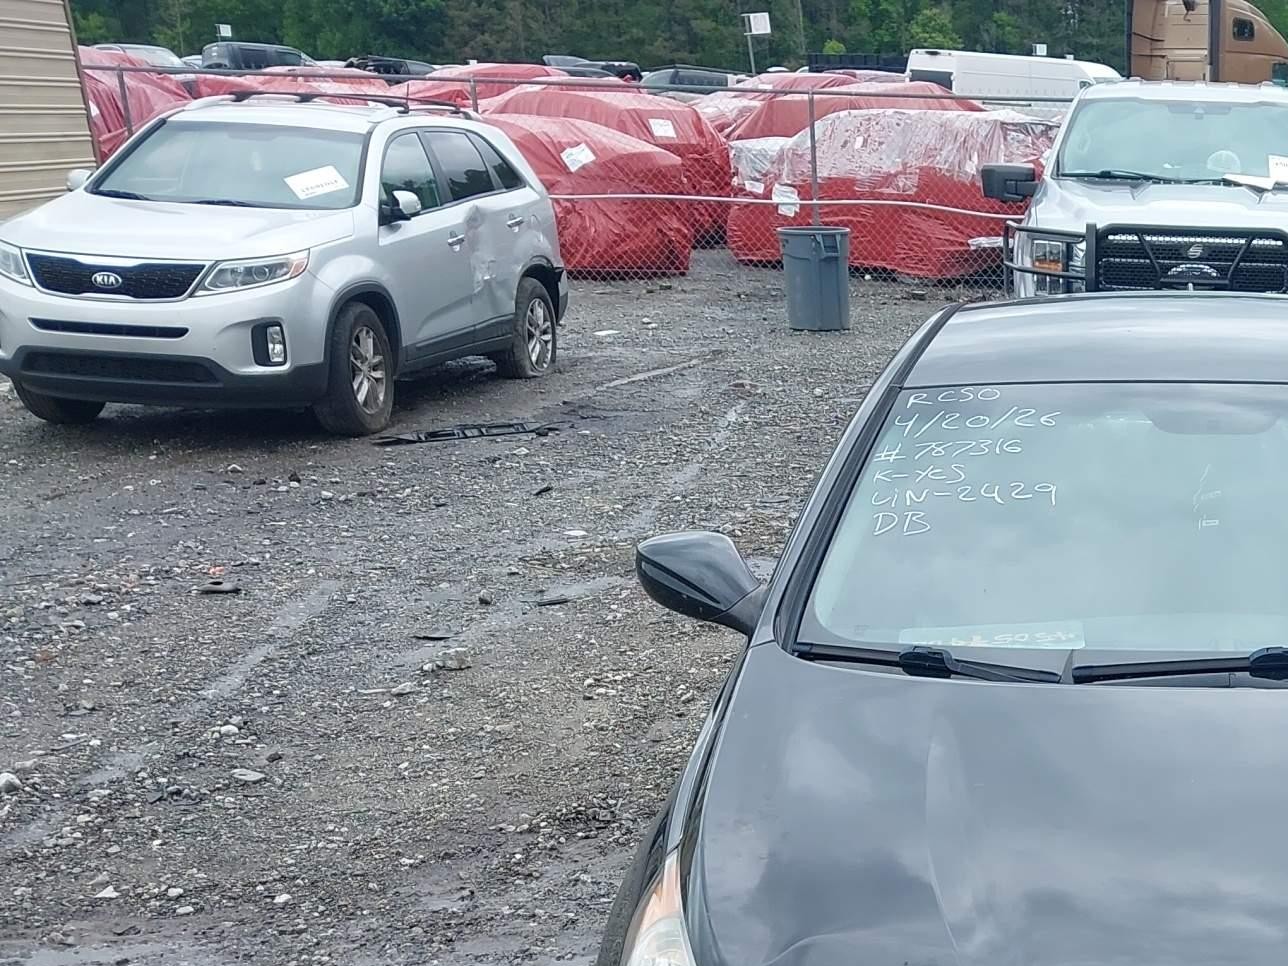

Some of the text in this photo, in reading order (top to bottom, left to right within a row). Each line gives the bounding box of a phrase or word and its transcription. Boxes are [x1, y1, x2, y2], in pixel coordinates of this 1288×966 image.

[96, 275, 116, 285] KIA
[894, 406, 1062, 437] 4/20/26
[873, 511, 931, 536] DB
